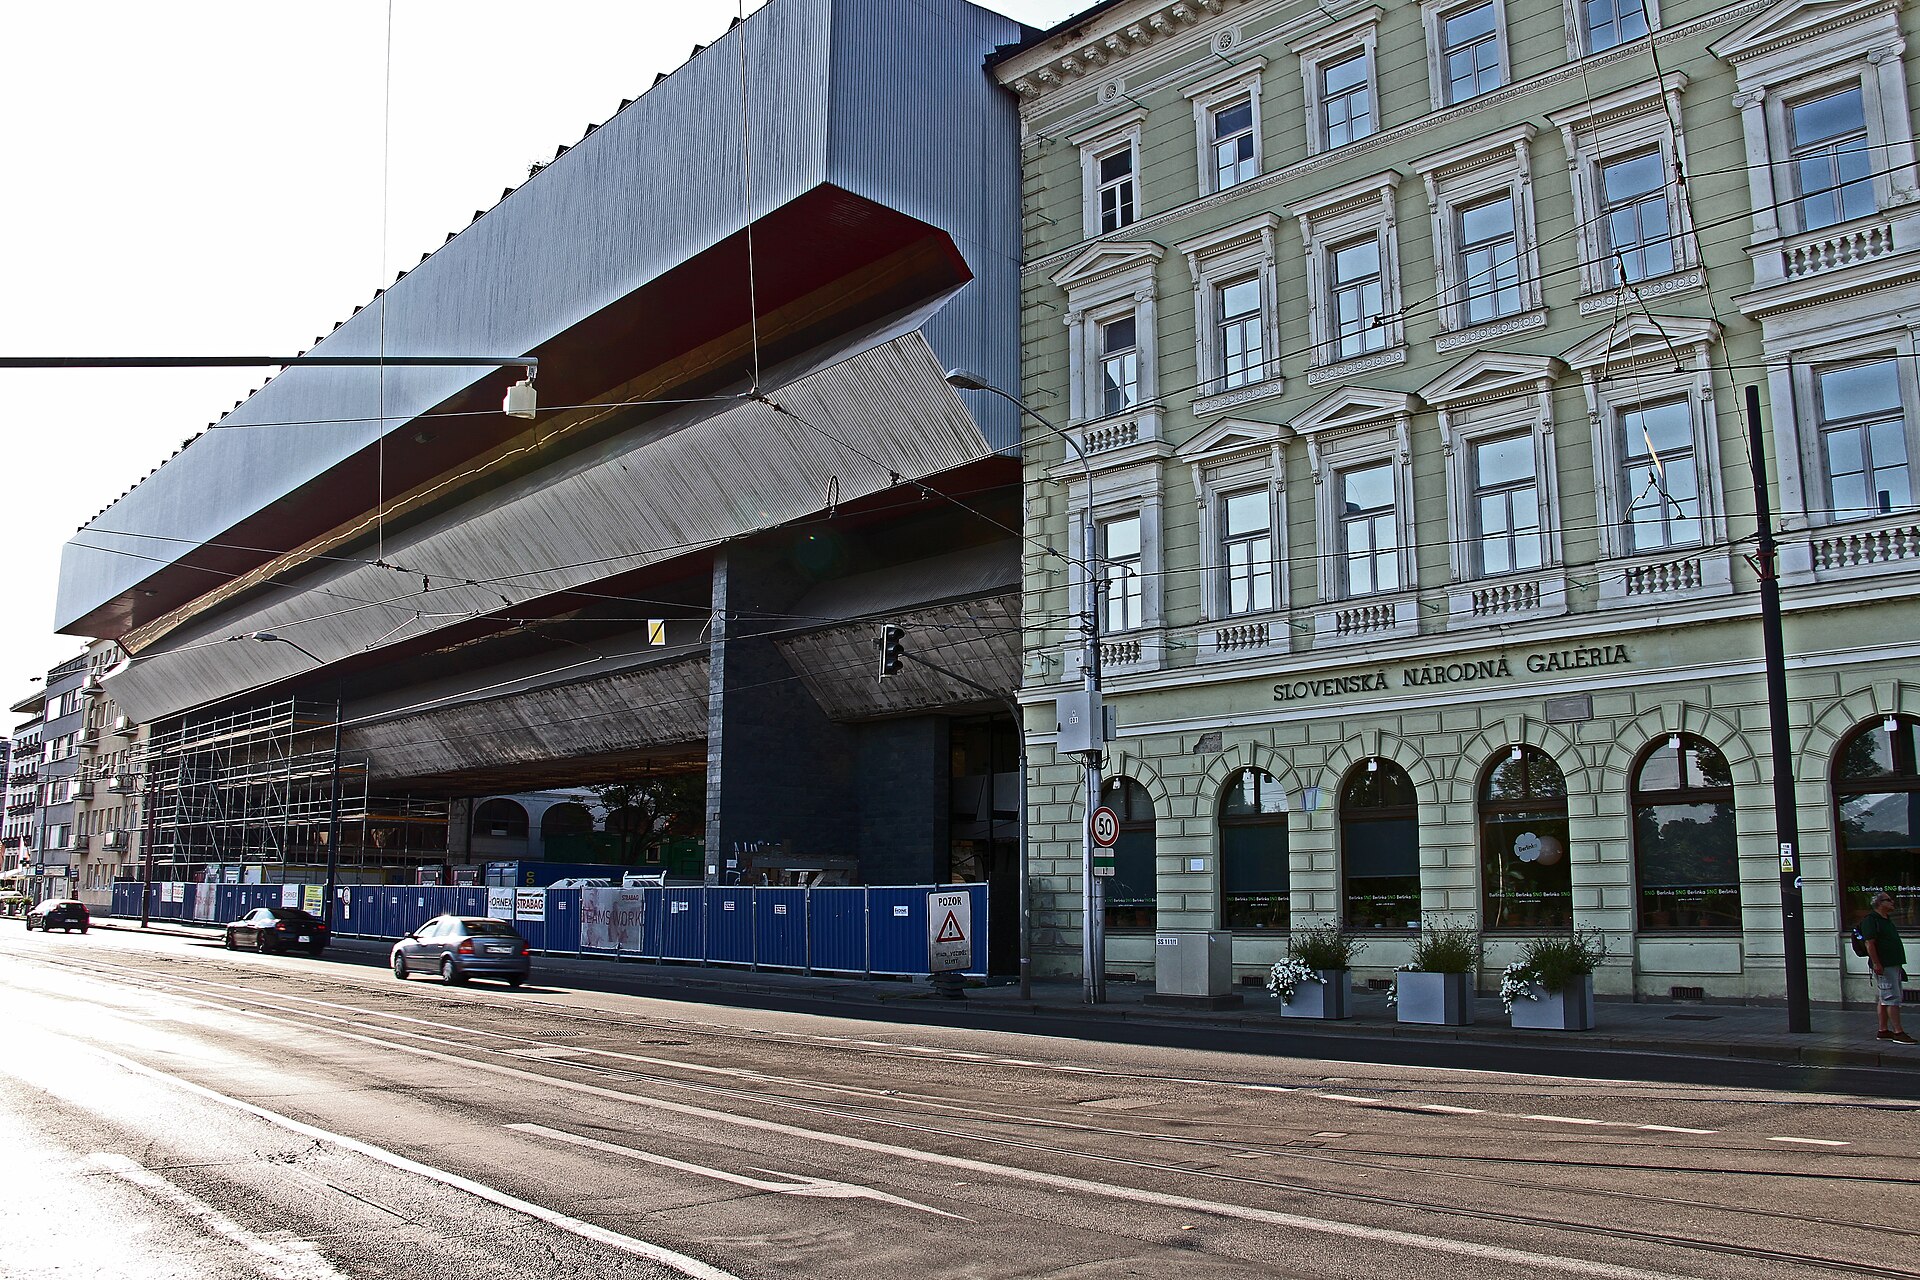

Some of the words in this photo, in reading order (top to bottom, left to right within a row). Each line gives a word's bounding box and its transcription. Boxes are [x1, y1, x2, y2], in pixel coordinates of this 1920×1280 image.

[1273, 669, 1389, 701] SLOVENSKÁ
[1402, 655, 1512, 686] NÁRODNÁ
[1526, 644, 1631, 673] GALÉRIA
[1097, 817, 1112, 836] 50
[490, 897, 512, 906] ORNEX
[518, 899, 544, 910] STRABAG
[938, 896, 962, 906] POZOR
